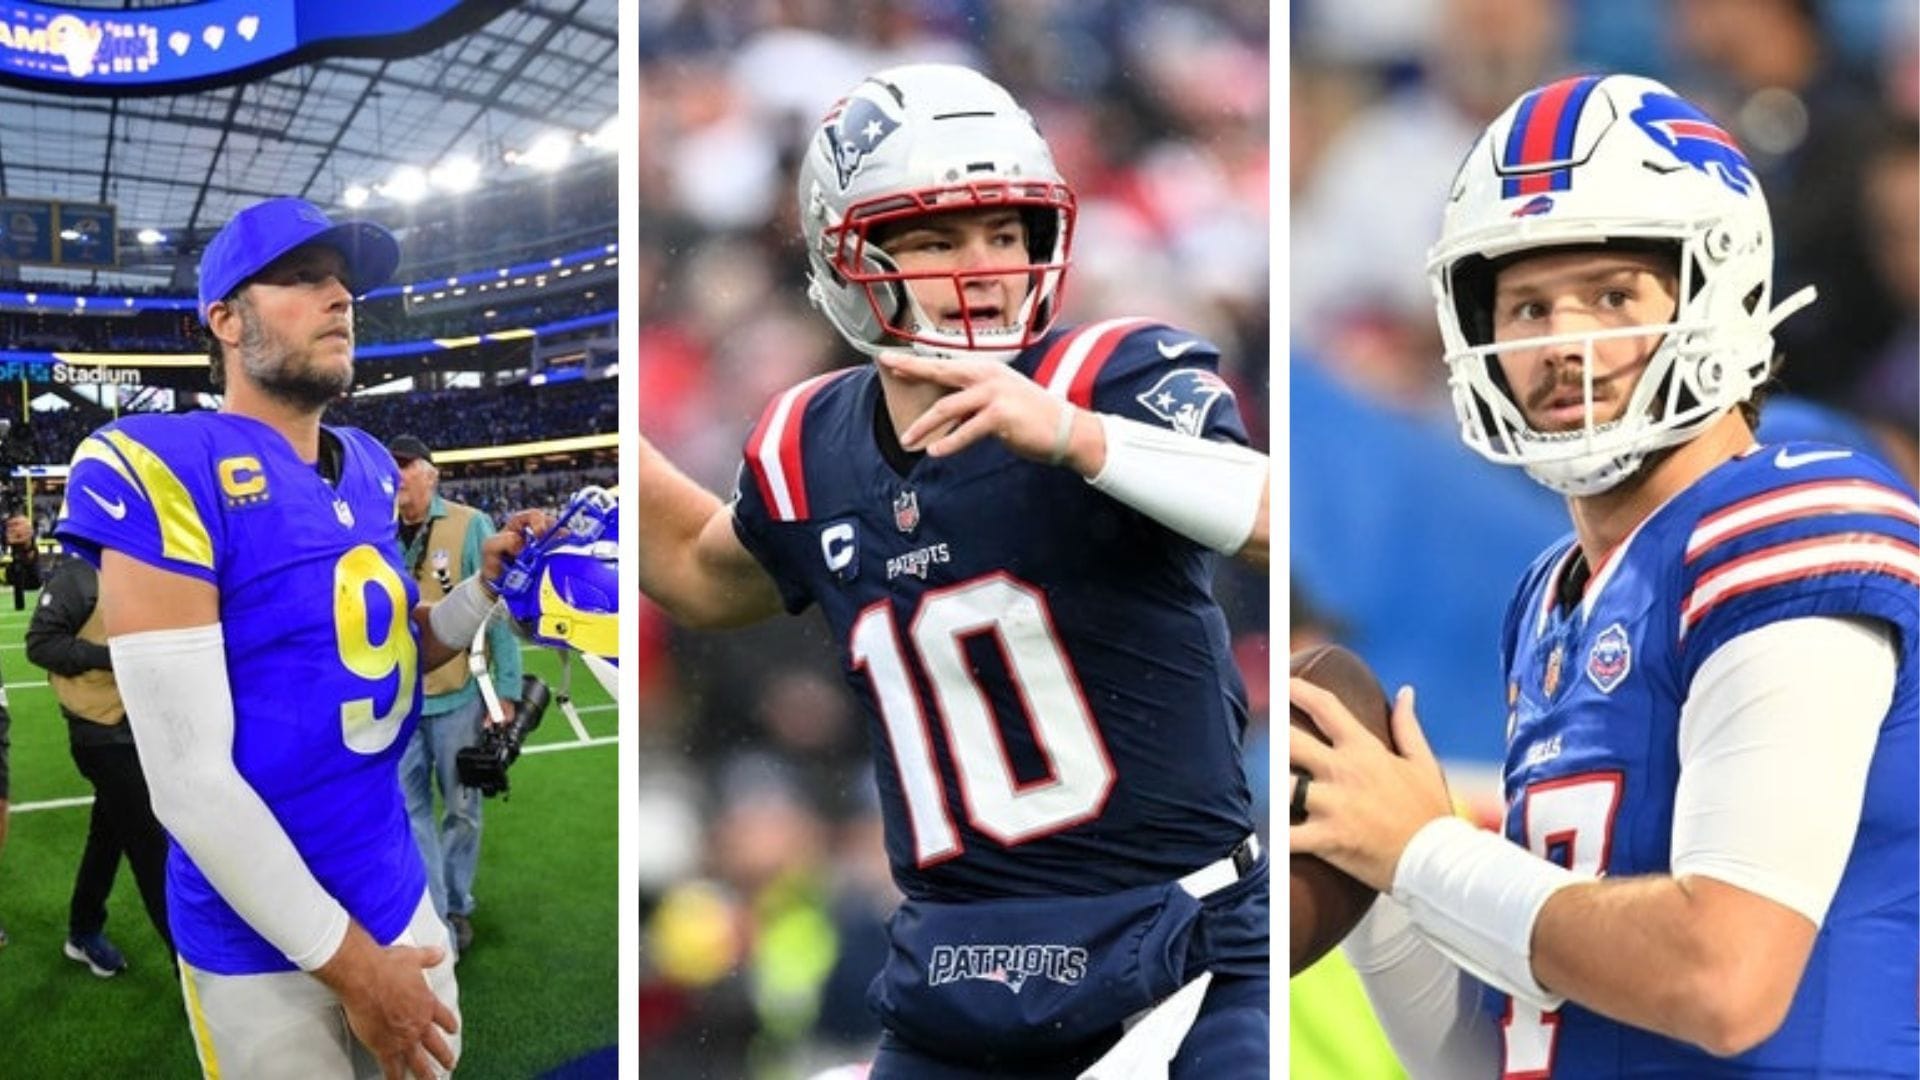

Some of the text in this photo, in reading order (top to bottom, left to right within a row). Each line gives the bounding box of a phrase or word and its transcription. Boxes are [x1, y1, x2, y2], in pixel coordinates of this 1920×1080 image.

[53, 363, 141, 384] Stadium
[218, 456, 266, 497] C
[821, 523, 855, 572] C
[886, 543, 951, 580] PATRIOTS
[334, 544, 418, 756] 9
[849, 569, 1118, 869] 10
[928, 945, 1089, 987] PATRIOTS
